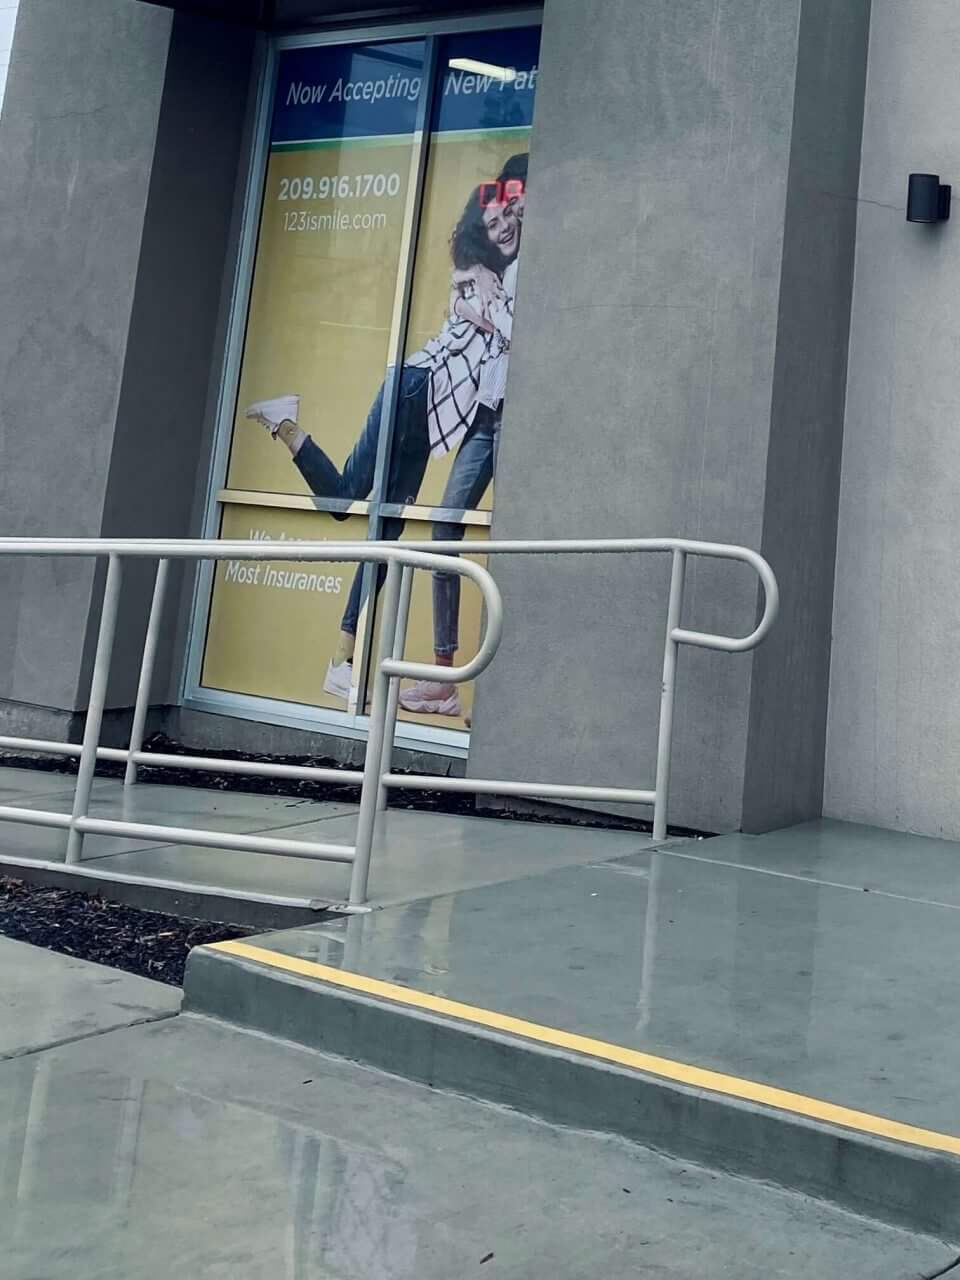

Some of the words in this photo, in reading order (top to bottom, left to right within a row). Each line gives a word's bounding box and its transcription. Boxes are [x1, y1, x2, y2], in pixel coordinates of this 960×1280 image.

[286, 81, 326, 106] Now
[329, 72, 421, 104] Accepting
[444, 71, 494, 96] New
[278, 173, 400, 201] 209.916.1700
[284, 210, 387, 232] 123ismile.com
[225, 560, 260, 585] Most
[263, 565, 343, 594] Insurances
